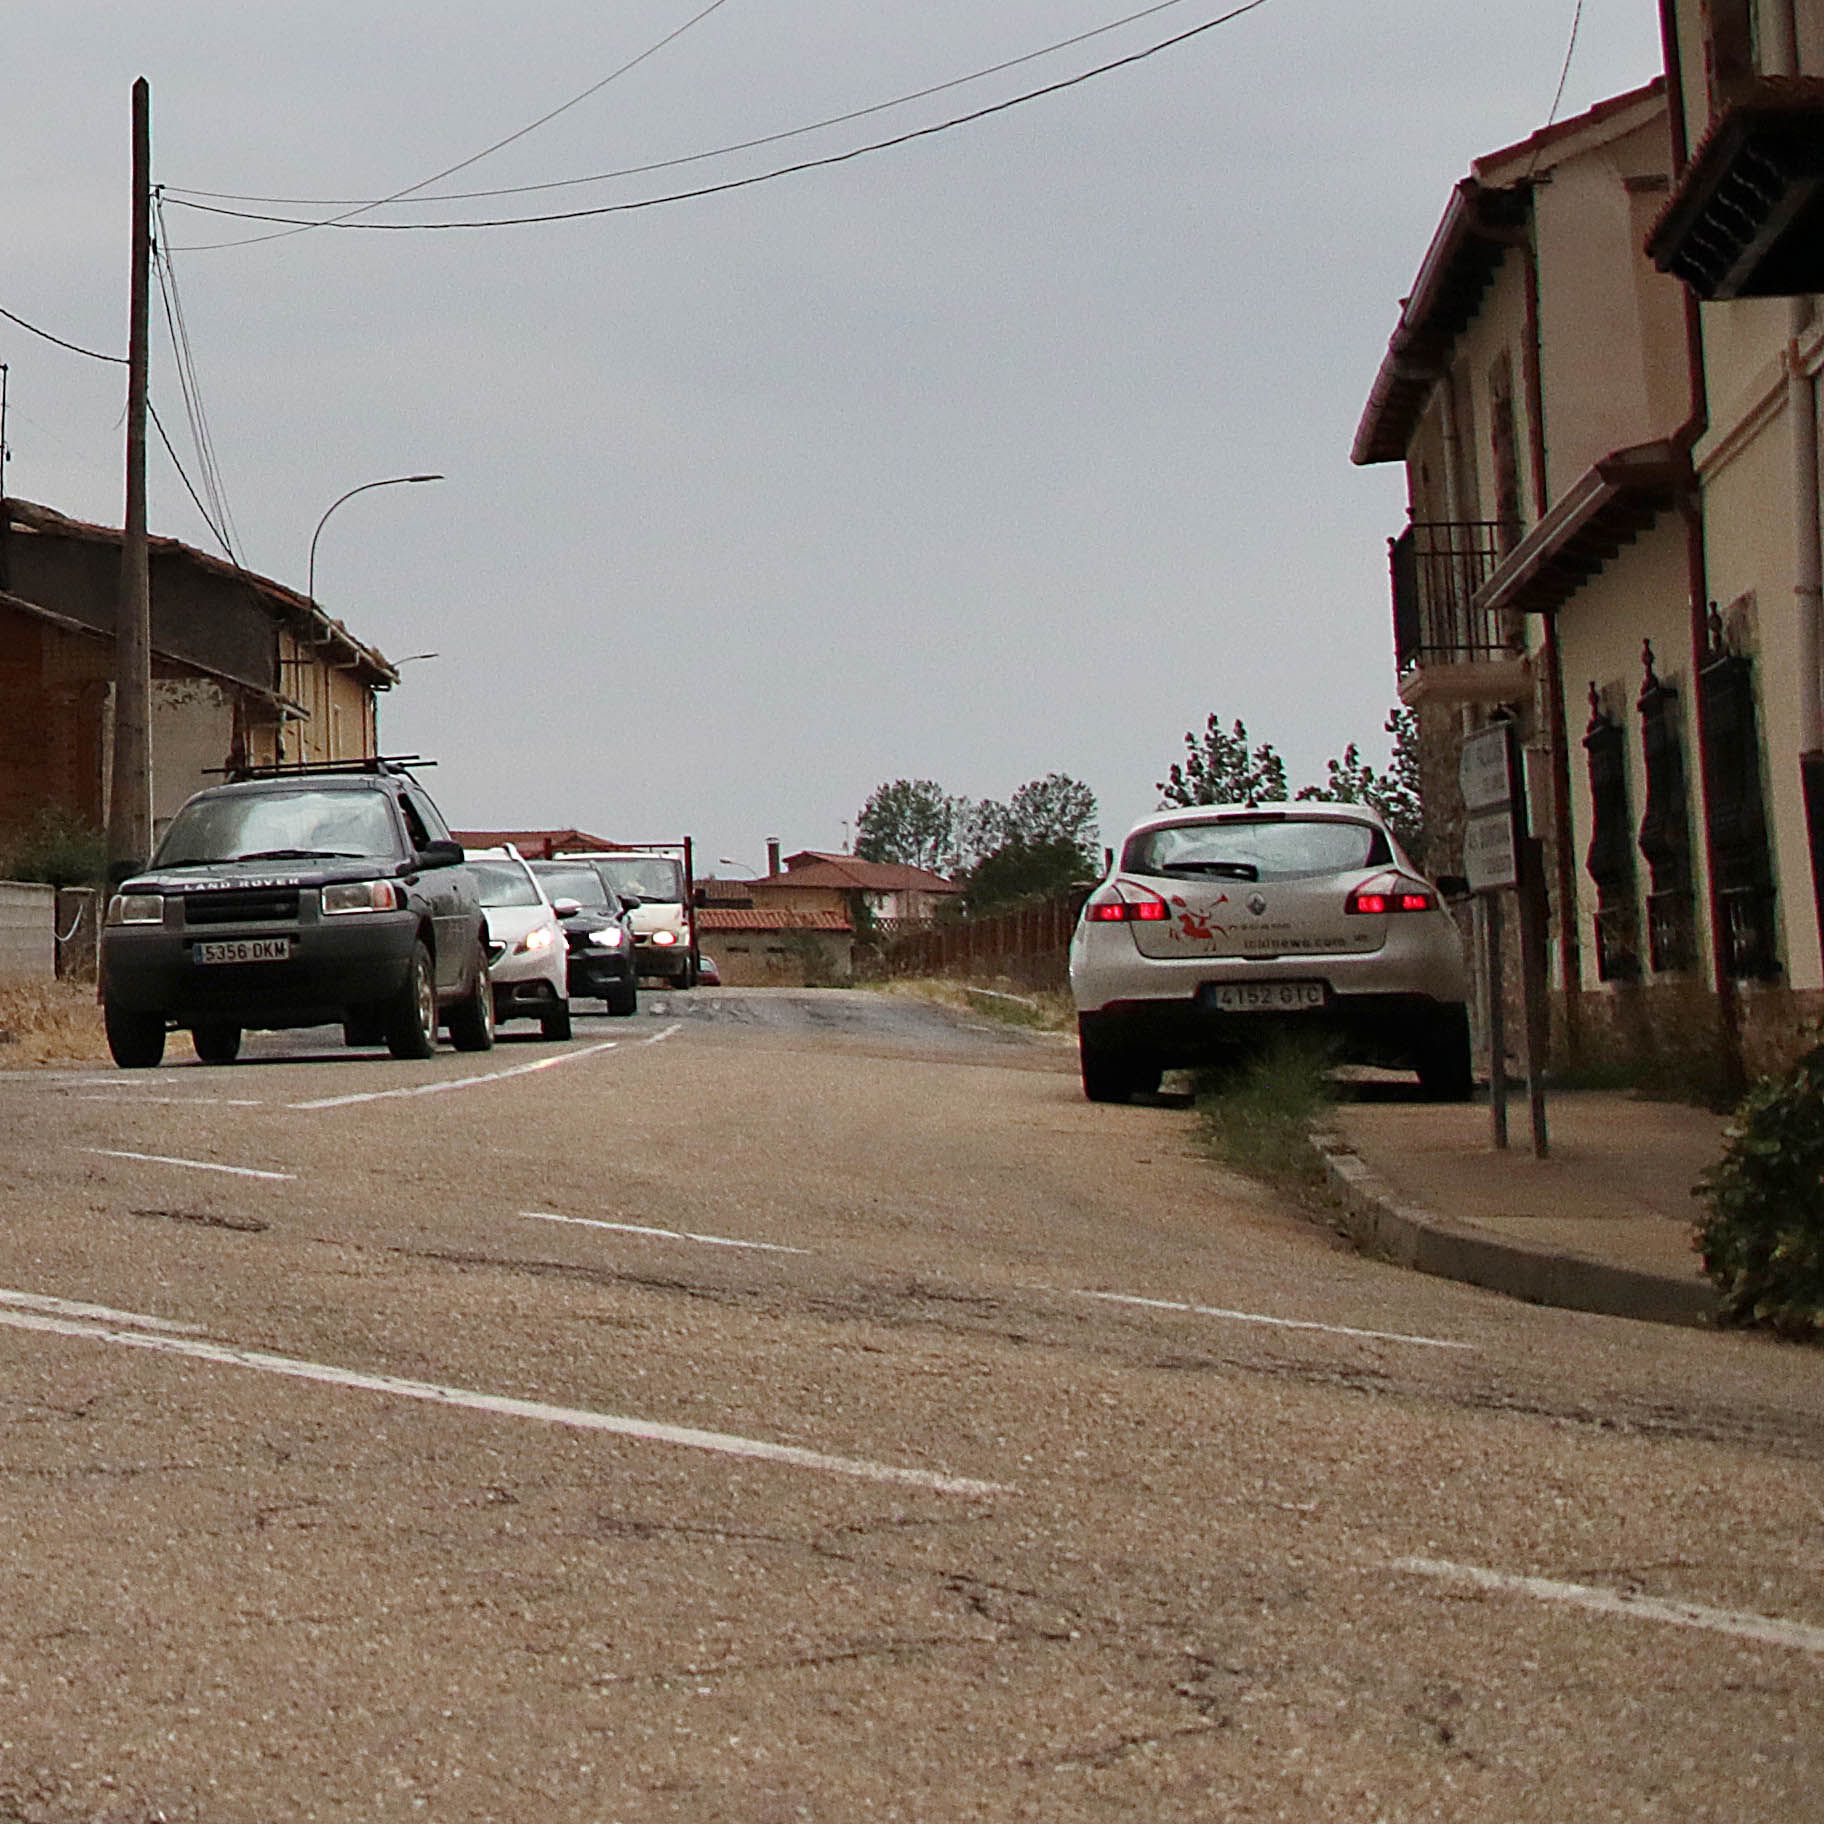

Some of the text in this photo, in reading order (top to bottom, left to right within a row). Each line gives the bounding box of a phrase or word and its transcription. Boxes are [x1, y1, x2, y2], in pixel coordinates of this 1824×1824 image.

[184, 877, 300, 891] LAND ROVER
[205, 943, 248, 961] 5356
